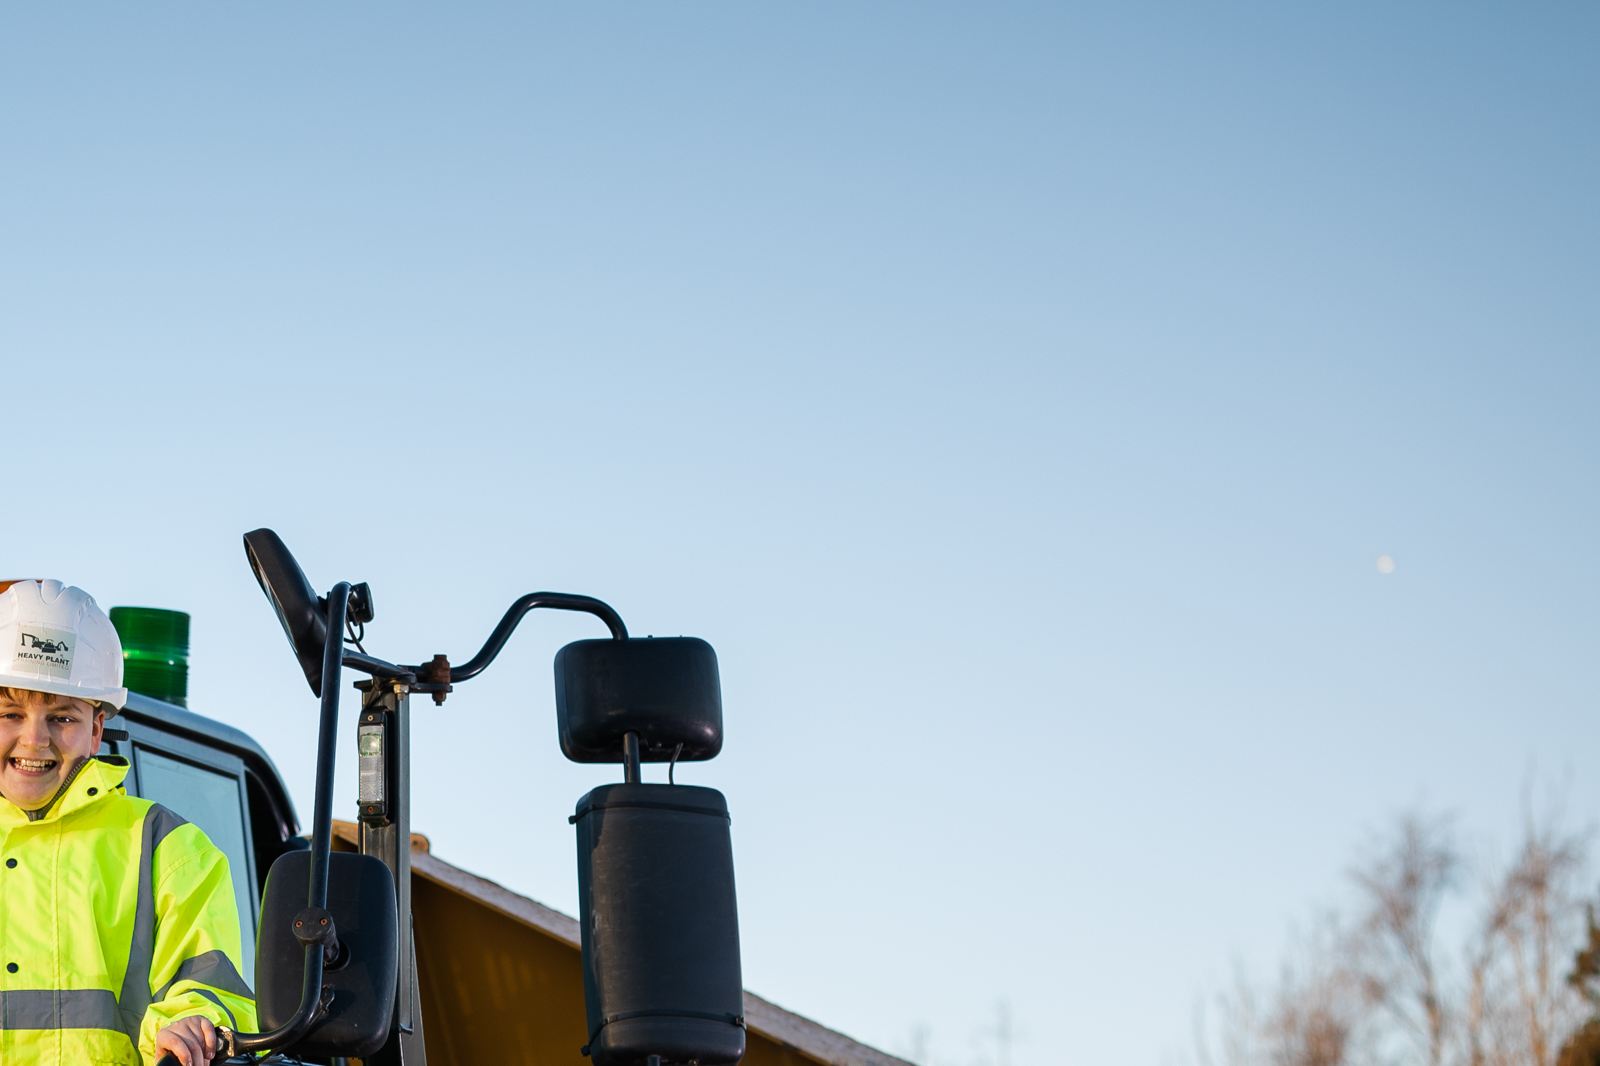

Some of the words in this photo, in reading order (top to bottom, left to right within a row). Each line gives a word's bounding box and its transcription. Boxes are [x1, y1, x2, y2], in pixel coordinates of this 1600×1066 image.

[17, 652, 44, 661] HEAVY
[45, 655, 70, 666] PLANT
[17, 657, 45, 666] TRAINING
[46, 661, 70, 671] LIMITED
